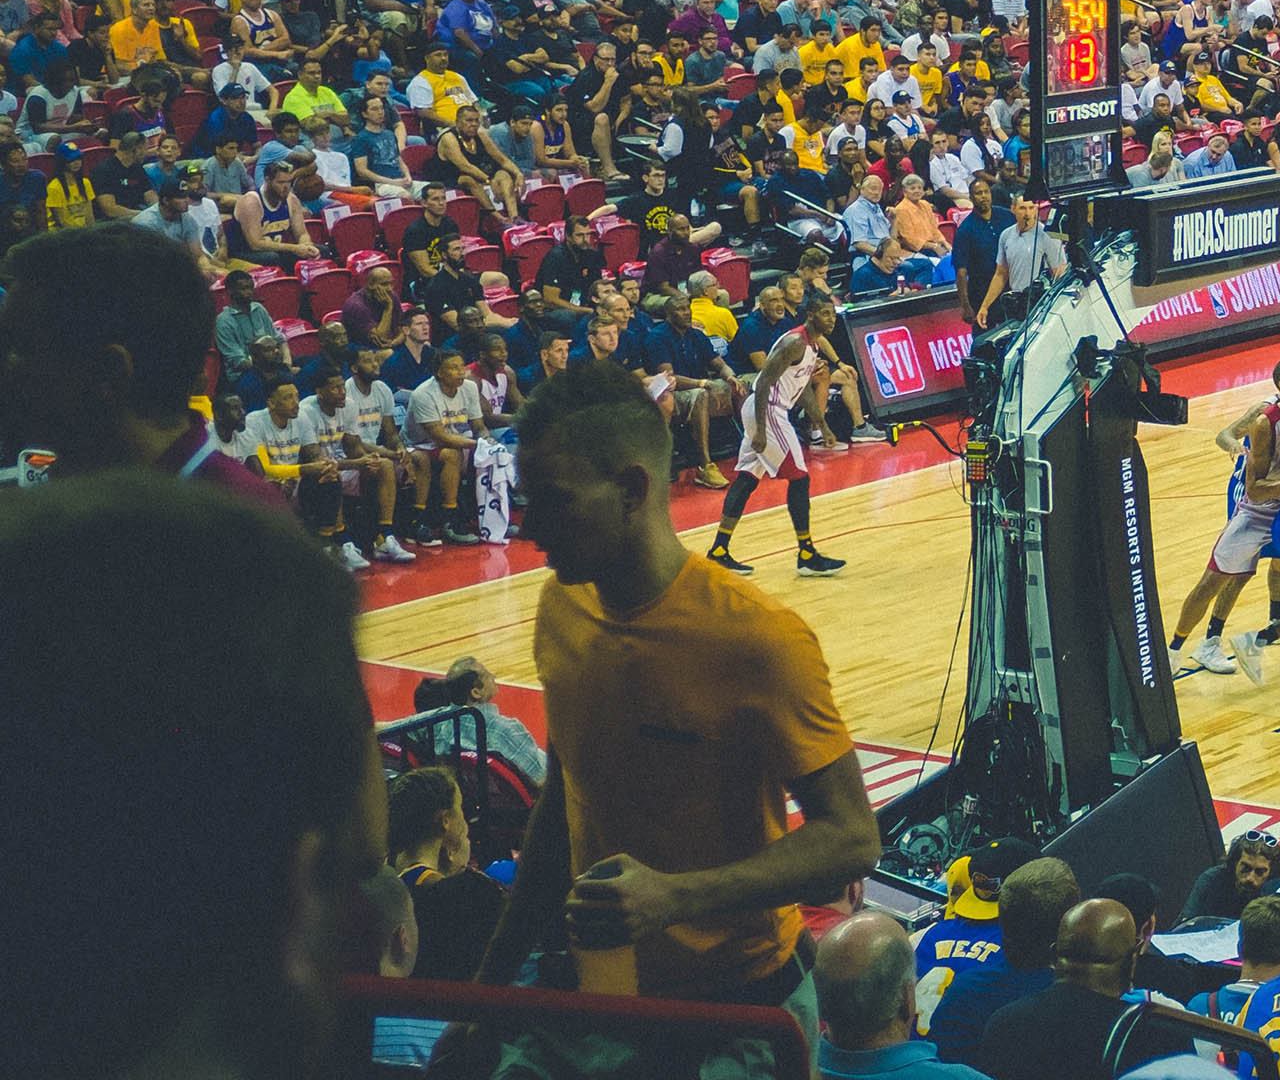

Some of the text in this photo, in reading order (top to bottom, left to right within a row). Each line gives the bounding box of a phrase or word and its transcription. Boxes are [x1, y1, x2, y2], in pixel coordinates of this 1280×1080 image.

[1069, 36, 1097, 84] 13
[1067, 100, 1118, 121] TISSOT
[1173, 207, 1279, 262] #NBASummer
[888, 340, 915, 381] TV
[928, 333, 973, 370] MGM
[1121, 457, 1155, 686] MGM RESORTS INTERNATIONAL
[935, 939, 1000, 962] WEST
